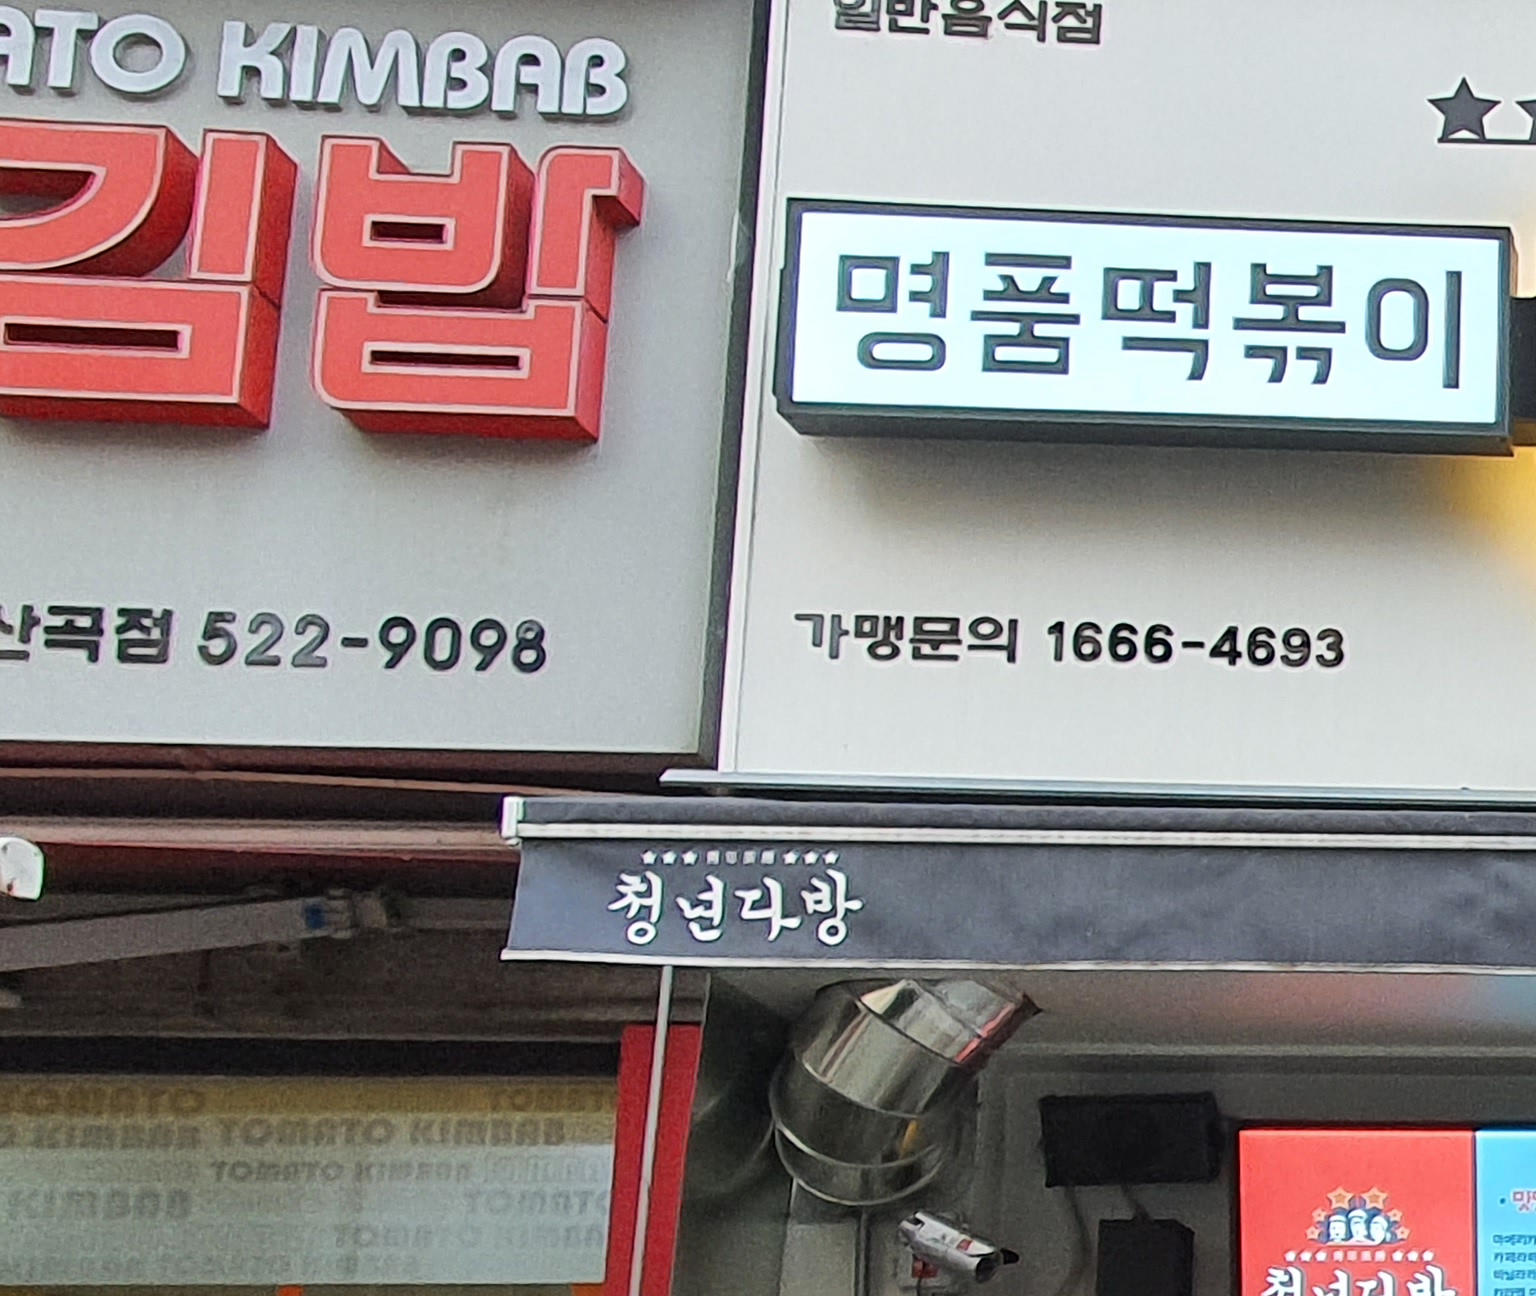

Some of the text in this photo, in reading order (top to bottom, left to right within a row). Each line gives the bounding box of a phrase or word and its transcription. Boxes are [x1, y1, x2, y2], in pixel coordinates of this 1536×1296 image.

[834, 0, 1102, 45] 일반음식점
[217, 20, 628, 116] KIMBAB
[0, 118, 645, 442] 김밥
[836, 251, 1462, 389] 명품떡볶이
[198, 612, 547, 673] 522-9098
[794, 613, 1345, 668] 가맹문의 1666-4693
[607, 869, 864, 945] 청년다방
